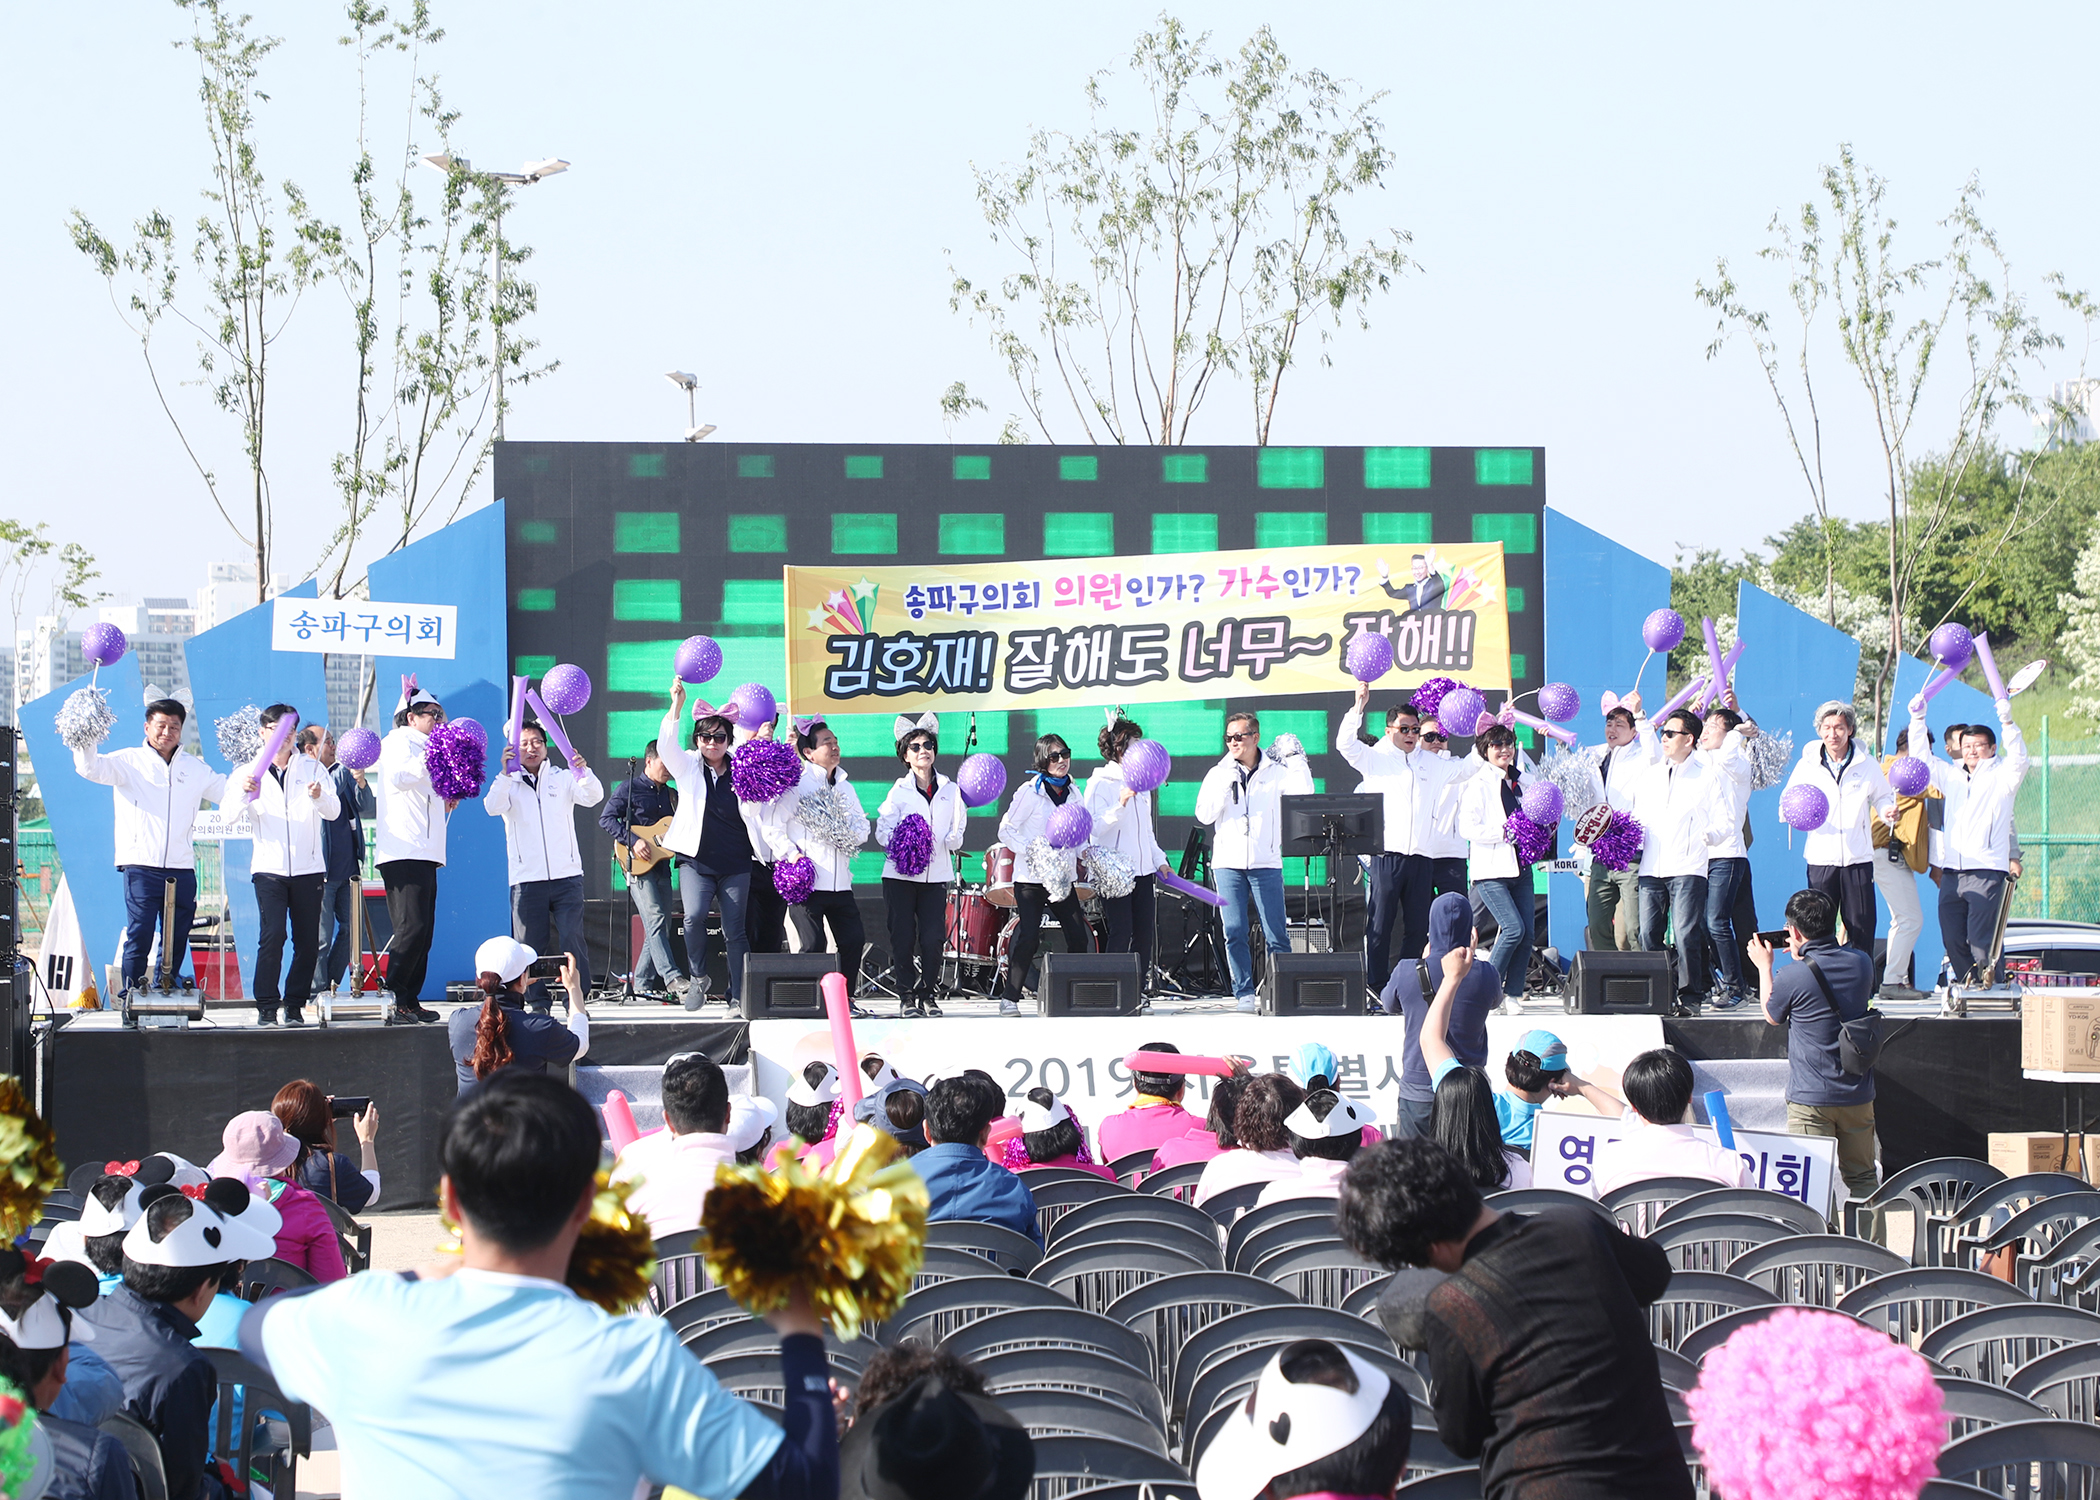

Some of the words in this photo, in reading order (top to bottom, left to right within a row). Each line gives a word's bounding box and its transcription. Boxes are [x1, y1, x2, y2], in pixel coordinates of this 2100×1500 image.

[905, 581, 1040, 619] 송파구의회
[1054, 573, 1205, 611] 의원인가?
[1218, 565, 1361, 599] 가수인가?
[289, 610, 442, 647] 송파구의회
[828, 635, 994, 693] 김호재!
[1009, 629, 1165, 689] 잘해도
[1184, 622, 1327, 677] 너무~
[1554, 860, 1578, 869] KORG
[1004, 1057, 1134, 1099] 2019
